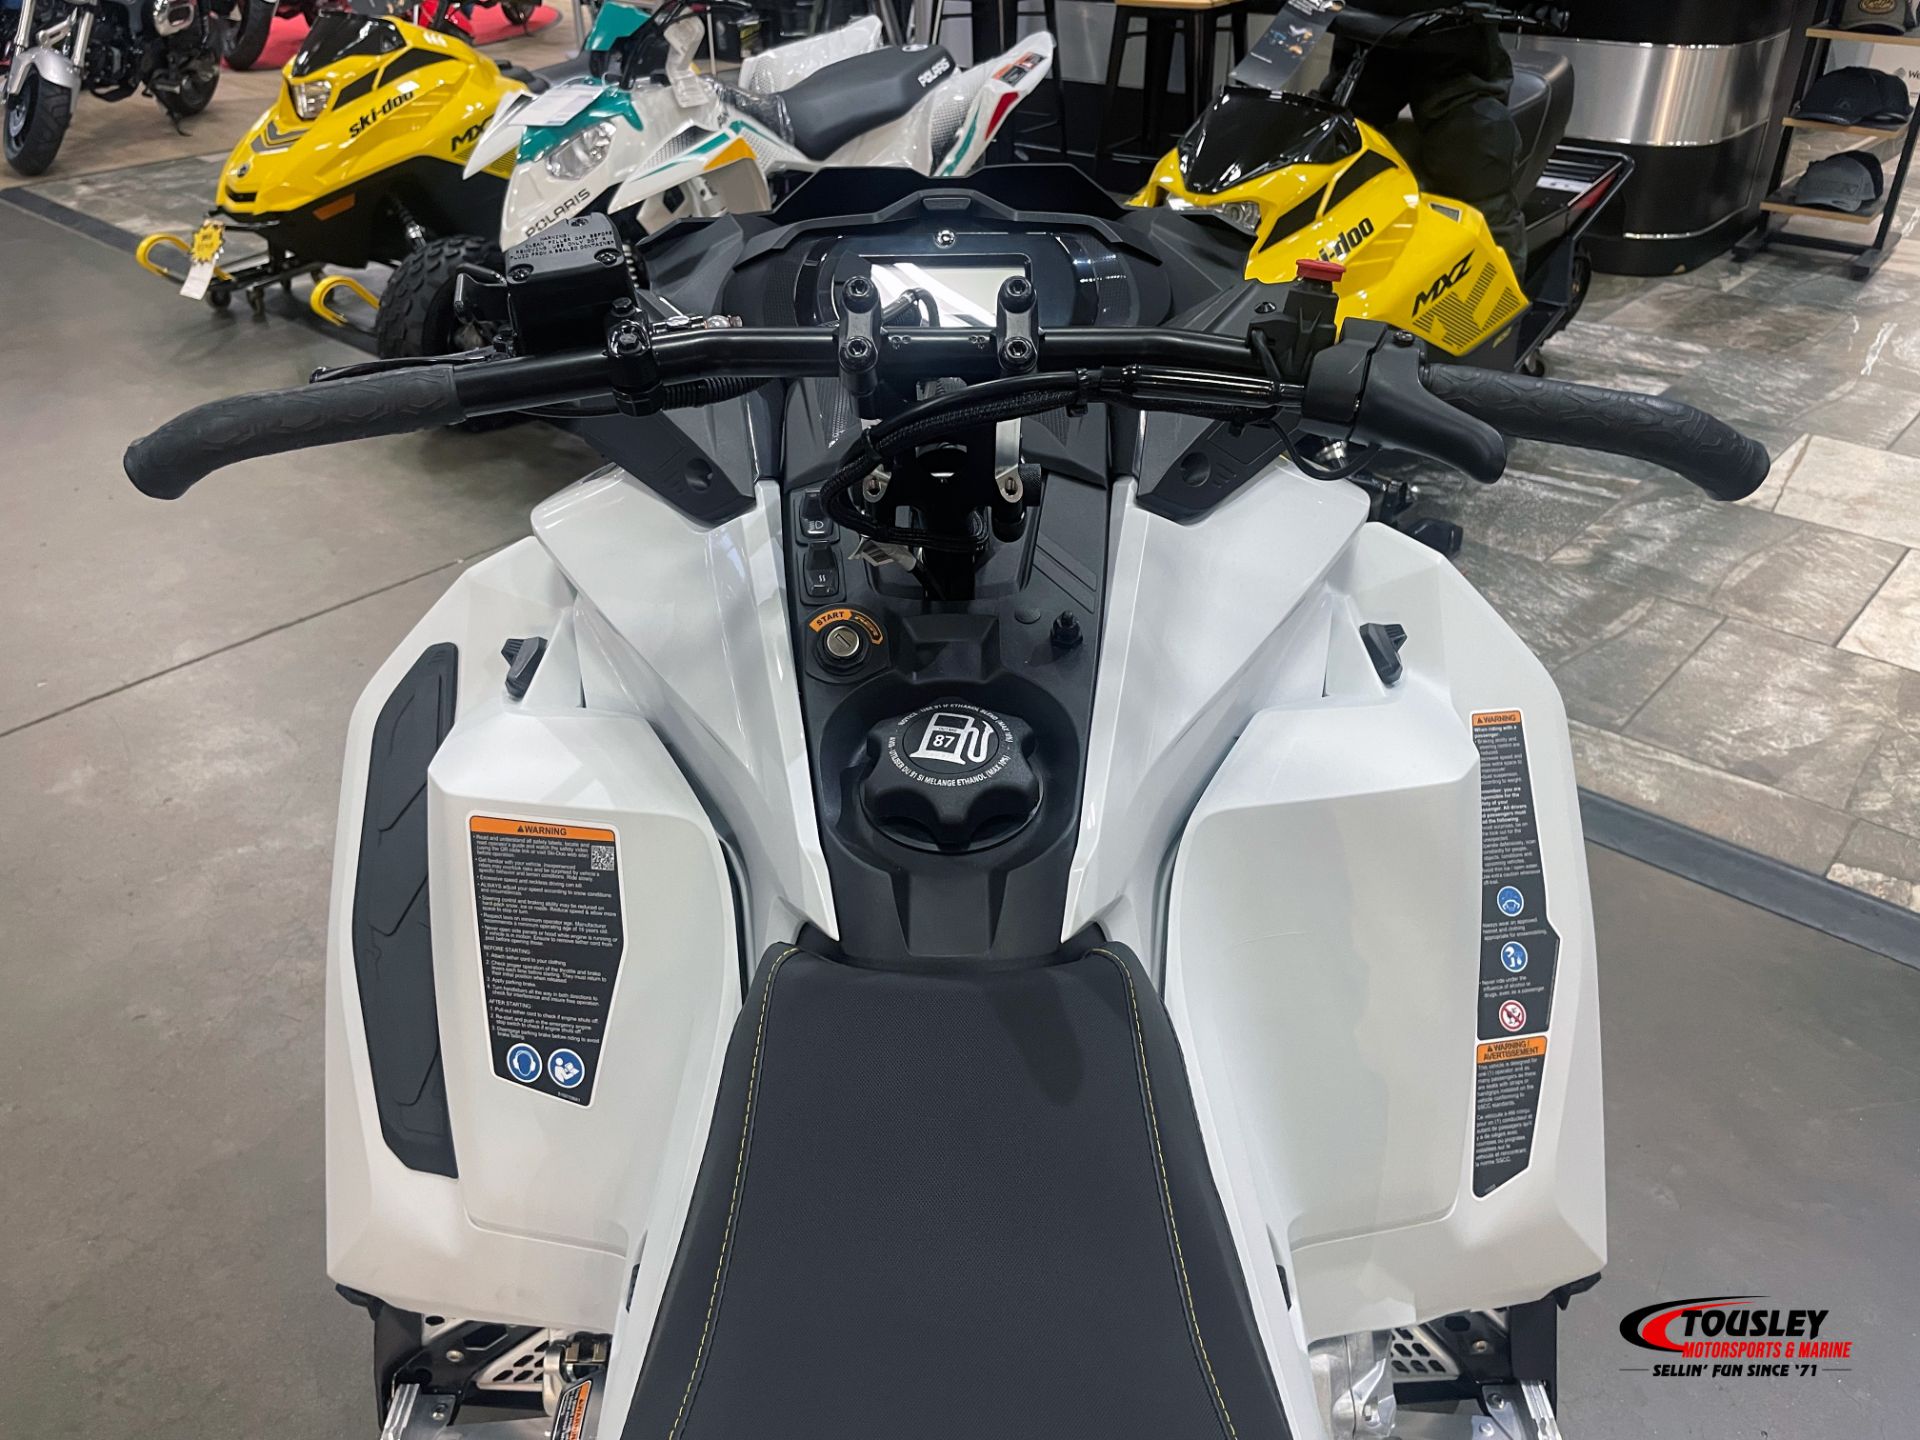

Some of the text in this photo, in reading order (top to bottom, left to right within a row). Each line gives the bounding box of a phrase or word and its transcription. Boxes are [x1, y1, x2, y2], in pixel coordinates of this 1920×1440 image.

[917, 57, 950, 88] POLARIS
[348, 91, 415, 138] ski-doo
[525, 188, 591, 238] POLARIS
[1412, 249, 1475, 318] MXZ
[816, 611, 845, 626] START
[1483, 714, 1516, 723] WARNING
[933, 734, 955, 748] 87
[956, 773, 988, 786] ETHANOL
[523, 825, 567, 836] WARNING
[1494, 1040, 1526, 1051] WARNING
[1483, 1046, 1539, 1061] AVERTISSEMENT
